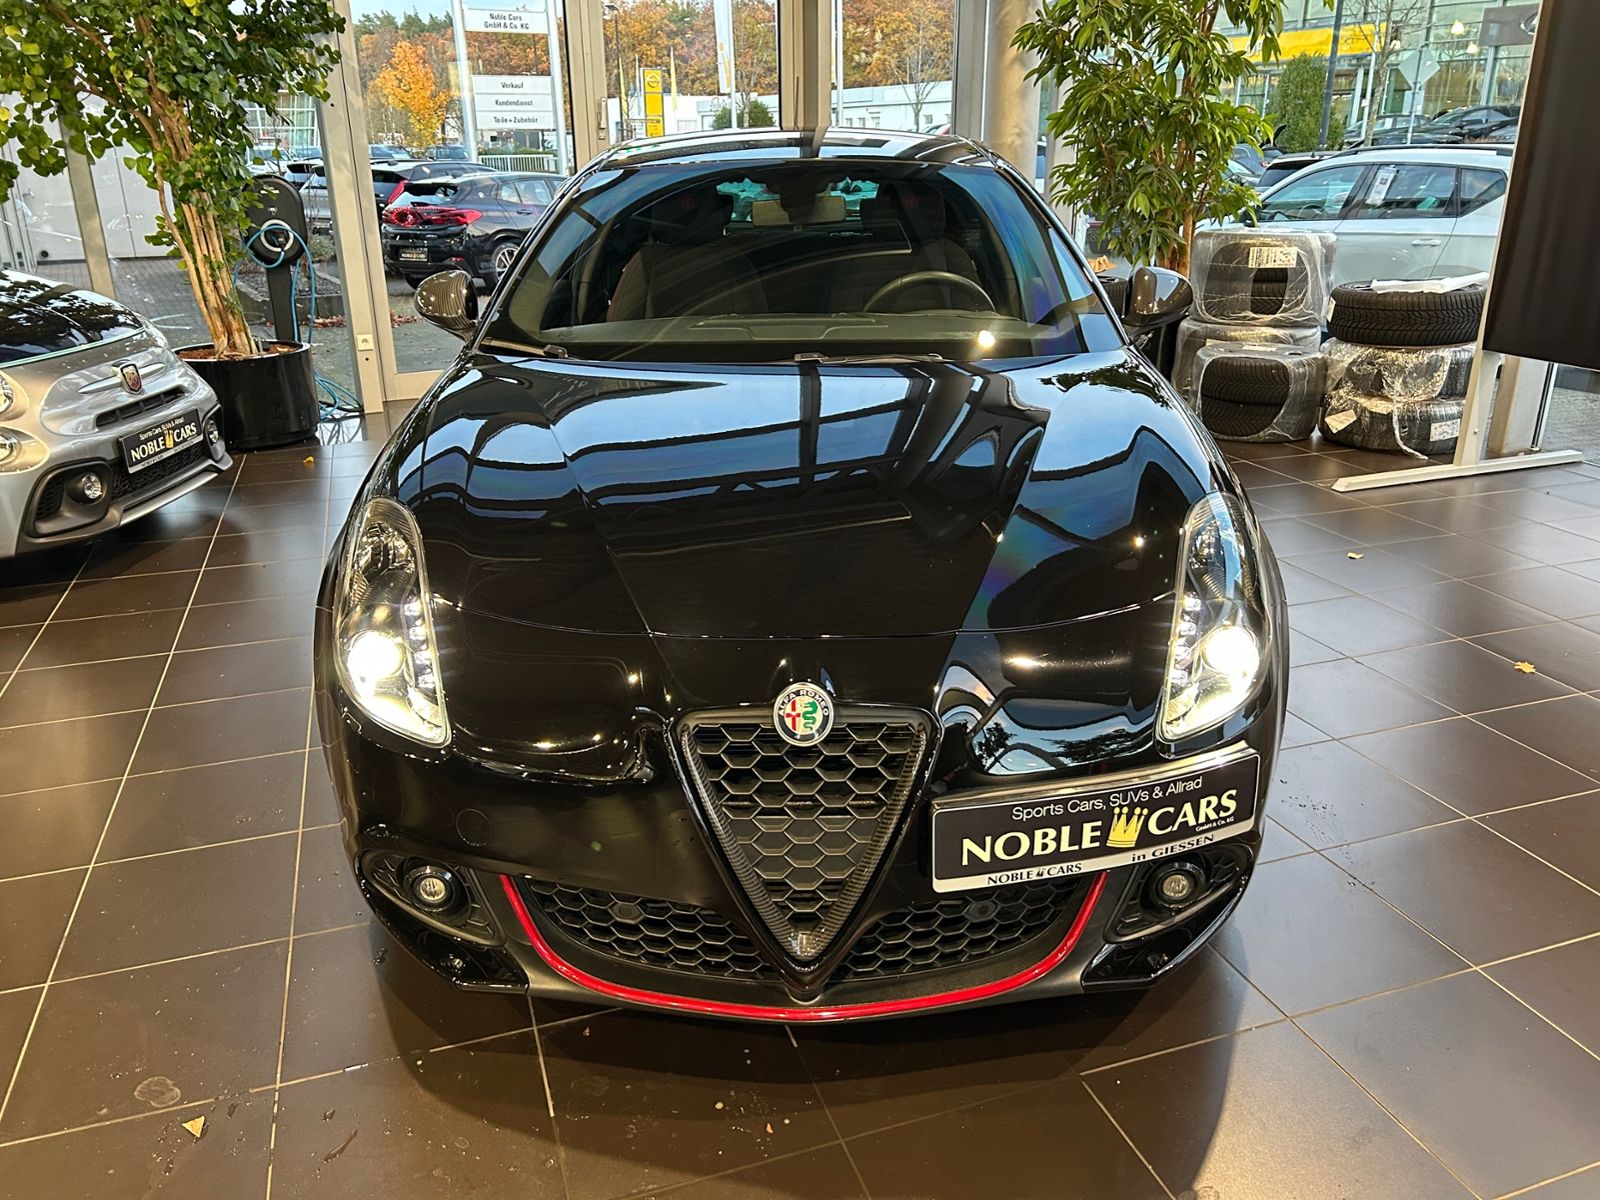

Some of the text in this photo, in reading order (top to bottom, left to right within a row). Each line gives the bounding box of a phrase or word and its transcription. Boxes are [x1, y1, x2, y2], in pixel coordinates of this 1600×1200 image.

[484, 21, 501, 29] GmbH
[489, 13, 506, 21] Noble
[131, 437, 165, 461] NOBLE
[173, 422, 197, 442] CARS
[778, 690, 829, 716] ALFA ROMEO
[1012, 776, 1202, 822] Sports Cars, SUVs & Allrad
[961, 789, 1238, 866] NOBLE CARS
[1132, 834, 1214, 862] in GIESSEN
[987, 863, 1082, 885] NOBLE CARS
